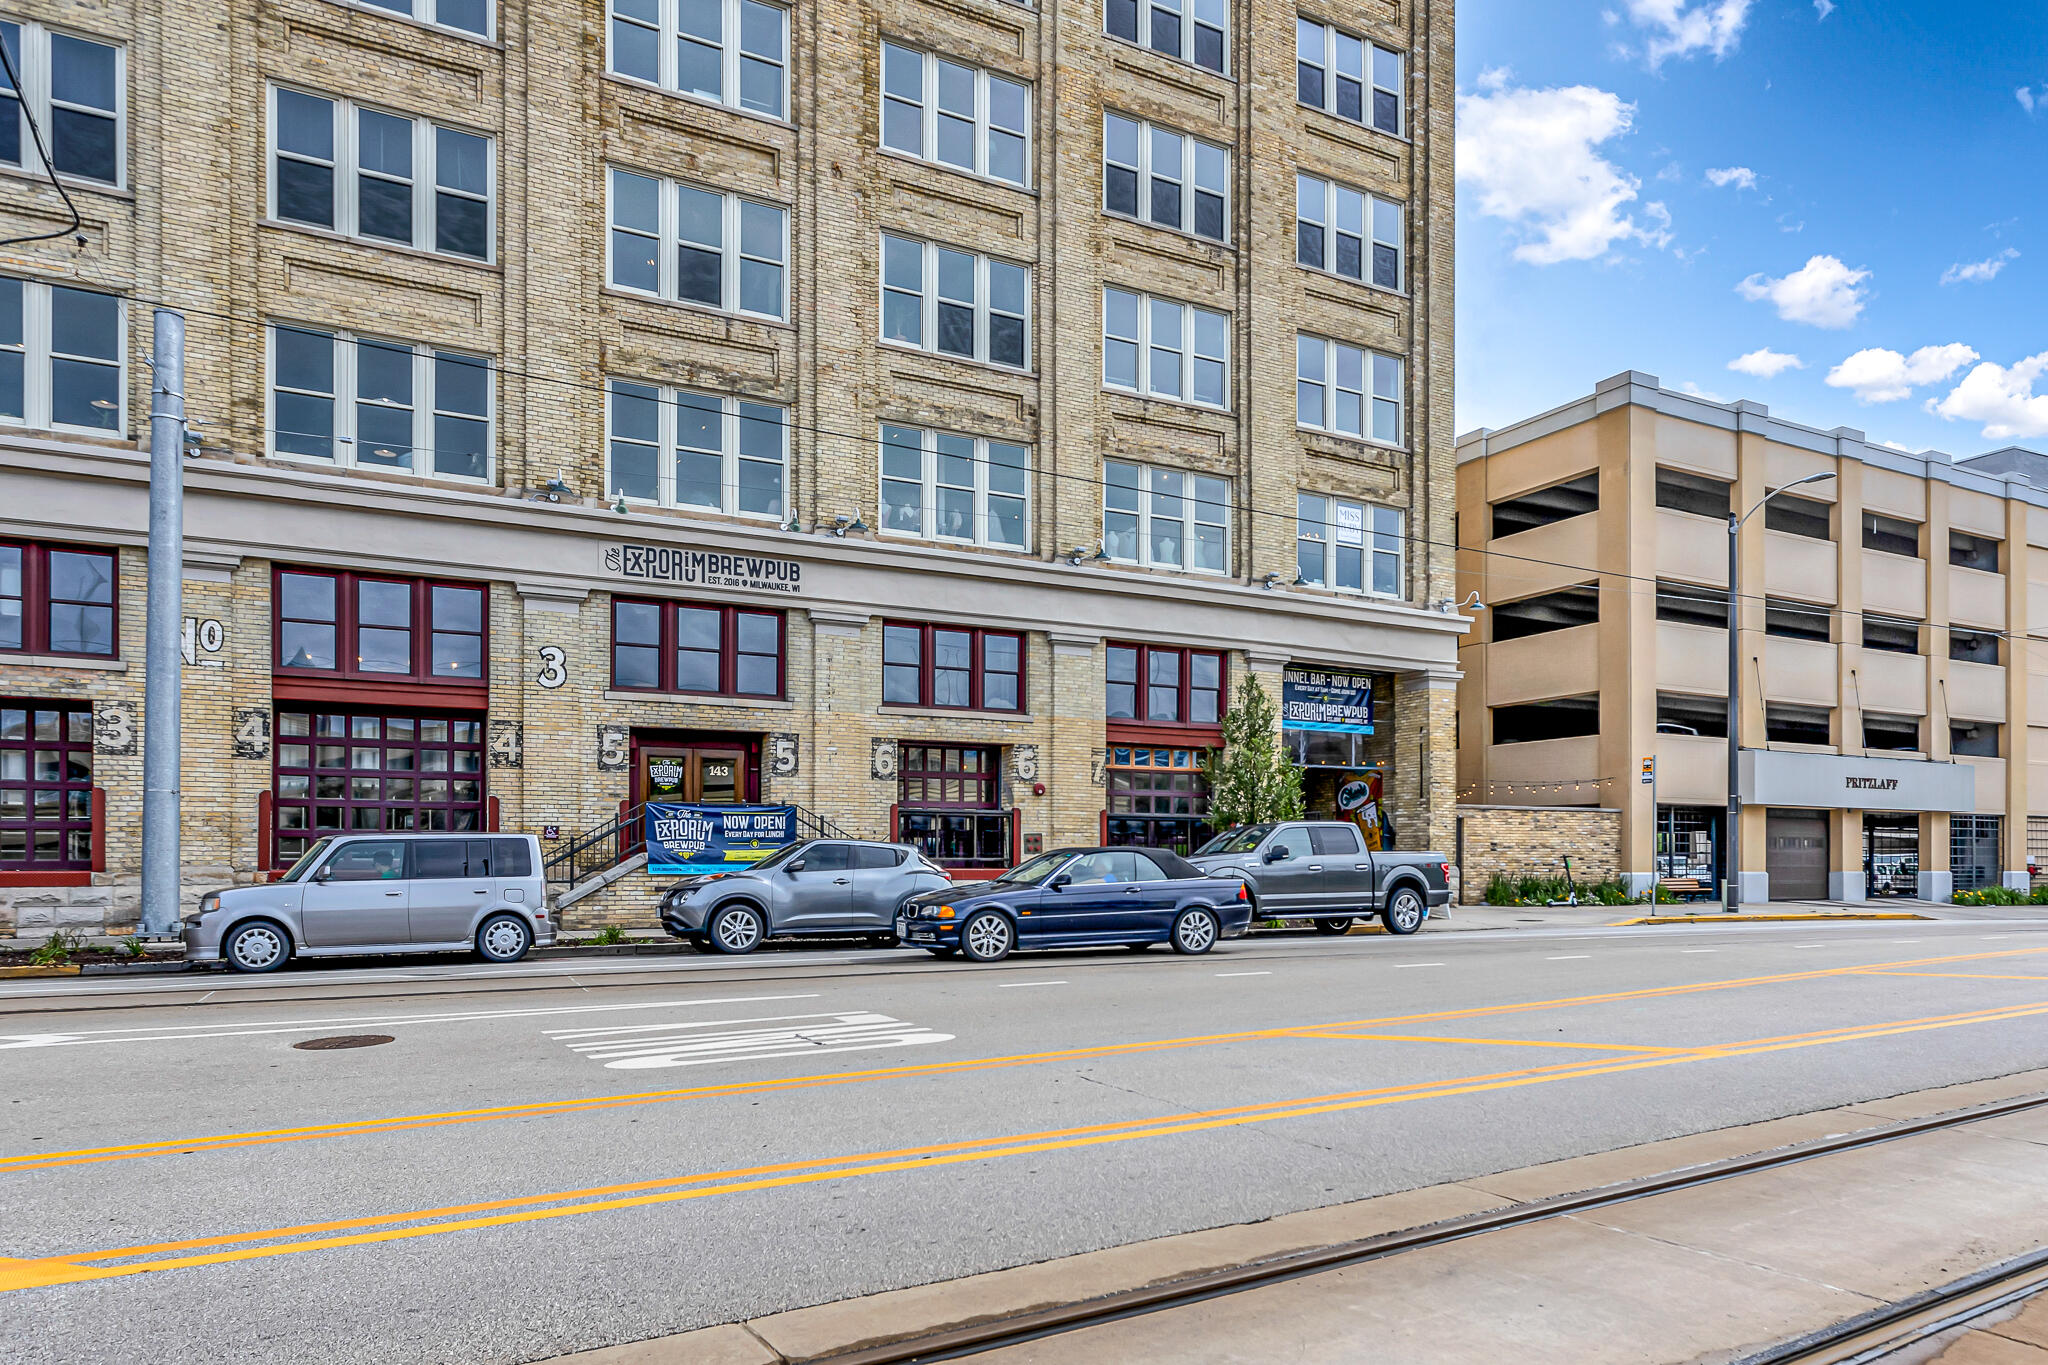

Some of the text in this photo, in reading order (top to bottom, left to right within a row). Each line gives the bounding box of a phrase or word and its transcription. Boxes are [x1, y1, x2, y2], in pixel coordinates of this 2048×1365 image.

[1339, 509, 1361, 522] MISS
[605, 547, 622, 572] The
[708, 554, 800, 582] BREWPUB
[708, 576, 800, 593] EST. 2016 MILWAUKEE, WI
[537, 645, 567, 689] 3
[1311, 673, 1326, 685] BAR
[1332, 675, 1350, 687] NOW
[1352, 677, 1371, 689] OPEN
[1327, 704, 1368, 719] BREWPUB
[99, 707, 132, 748] 3
[233, 713, 270, 752] 4
[491, 728, 521, 762] 4
[601, 733, 624, 765] 5
[775, 741, 796, 771] 5
[875, 743, 894, 775] 6
[709, 766, 729, 776] 143
[1018, 748, 1036, 780] 6
[1845, 776, 1898, 790] PRITZLAFF
[677, 809, 692, 818] The
[723, 815, 786, 829] NOW OPEN!
[663, 841, 706, 850] BREWPUB
[541, 1011, 956, 1070] ONLY
